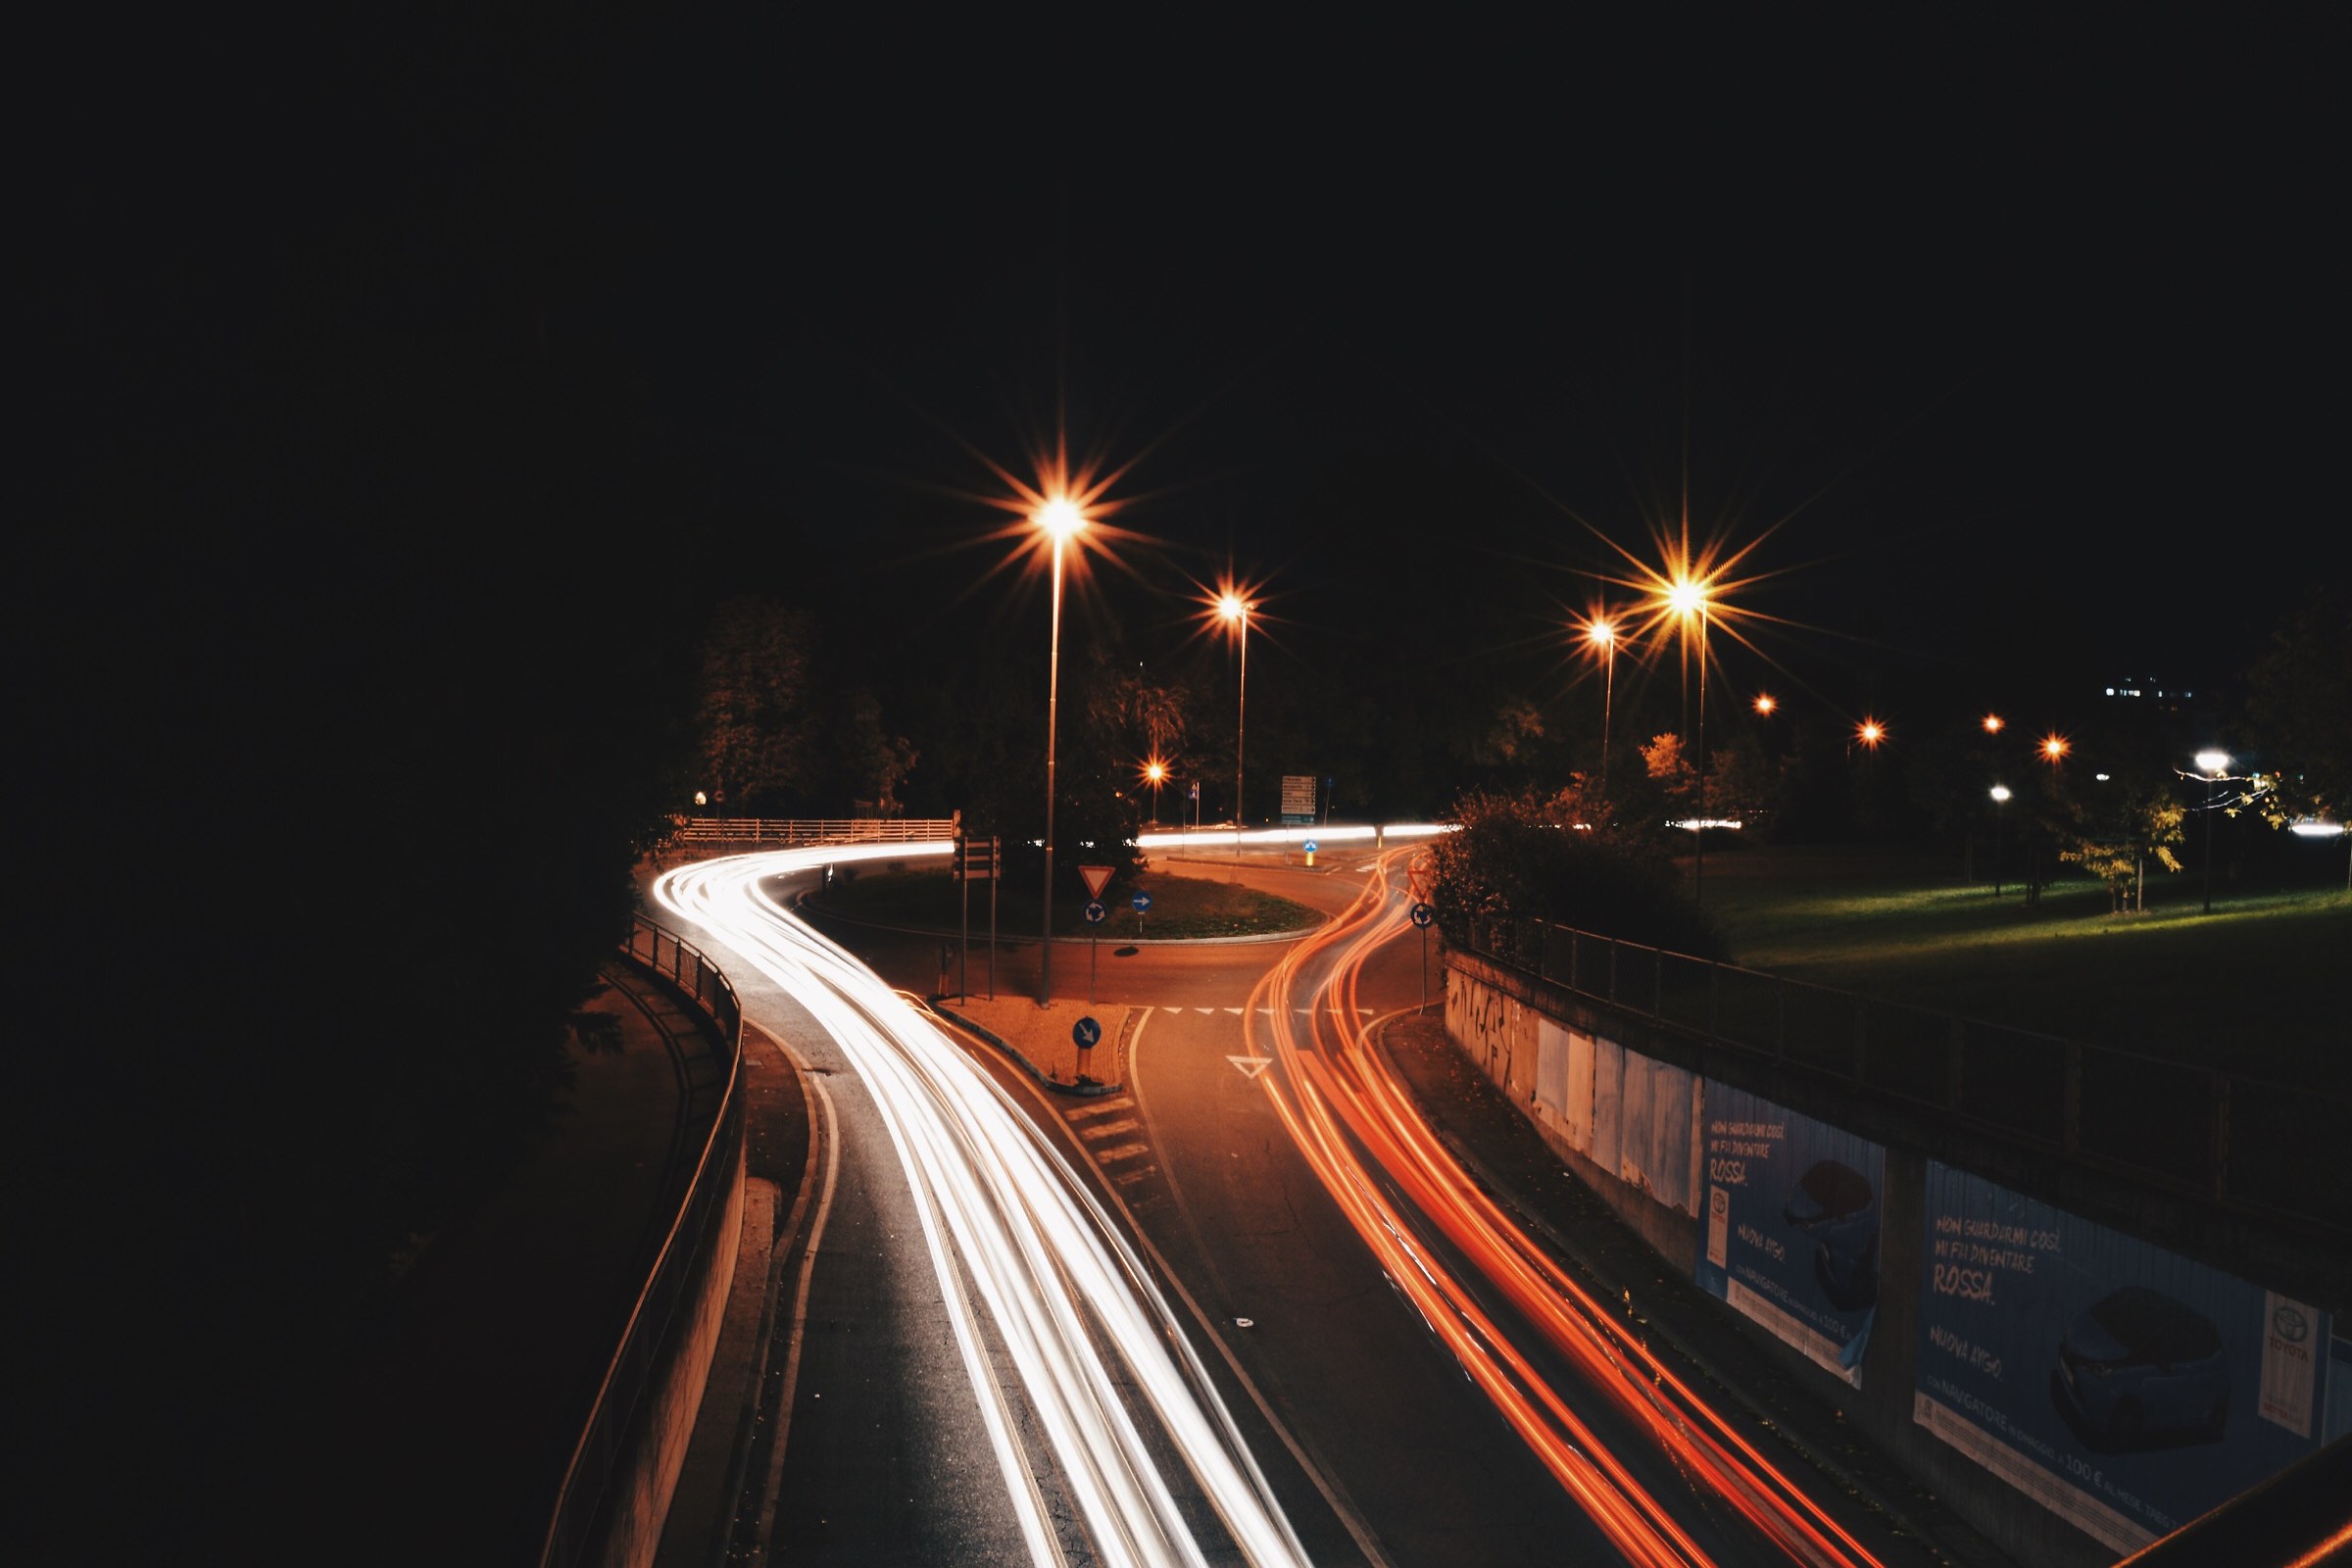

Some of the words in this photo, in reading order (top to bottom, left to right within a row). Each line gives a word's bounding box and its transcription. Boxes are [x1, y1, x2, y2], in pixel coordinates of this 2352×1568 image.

[1936, 1214, 1962, 1236] NON
[1964, 1218, 2028, 1247] GUARDARMI
[1935, 1239, 1948, 1256] MI
[1970, 1242, 2035, 1274] DIVENTARE
[1933, 1262, 1995, 1306] ROSSA.
[1930, 1325, 1969, 1361] NUOVA
[2269, 1336, 2308, 1363] TOYOTA
[1941, 1379, 2008, 1431] NAVIGATORE
[2066, 1453, 2091, 1481] 100
[2093, 1471, 2103, 1489] €
